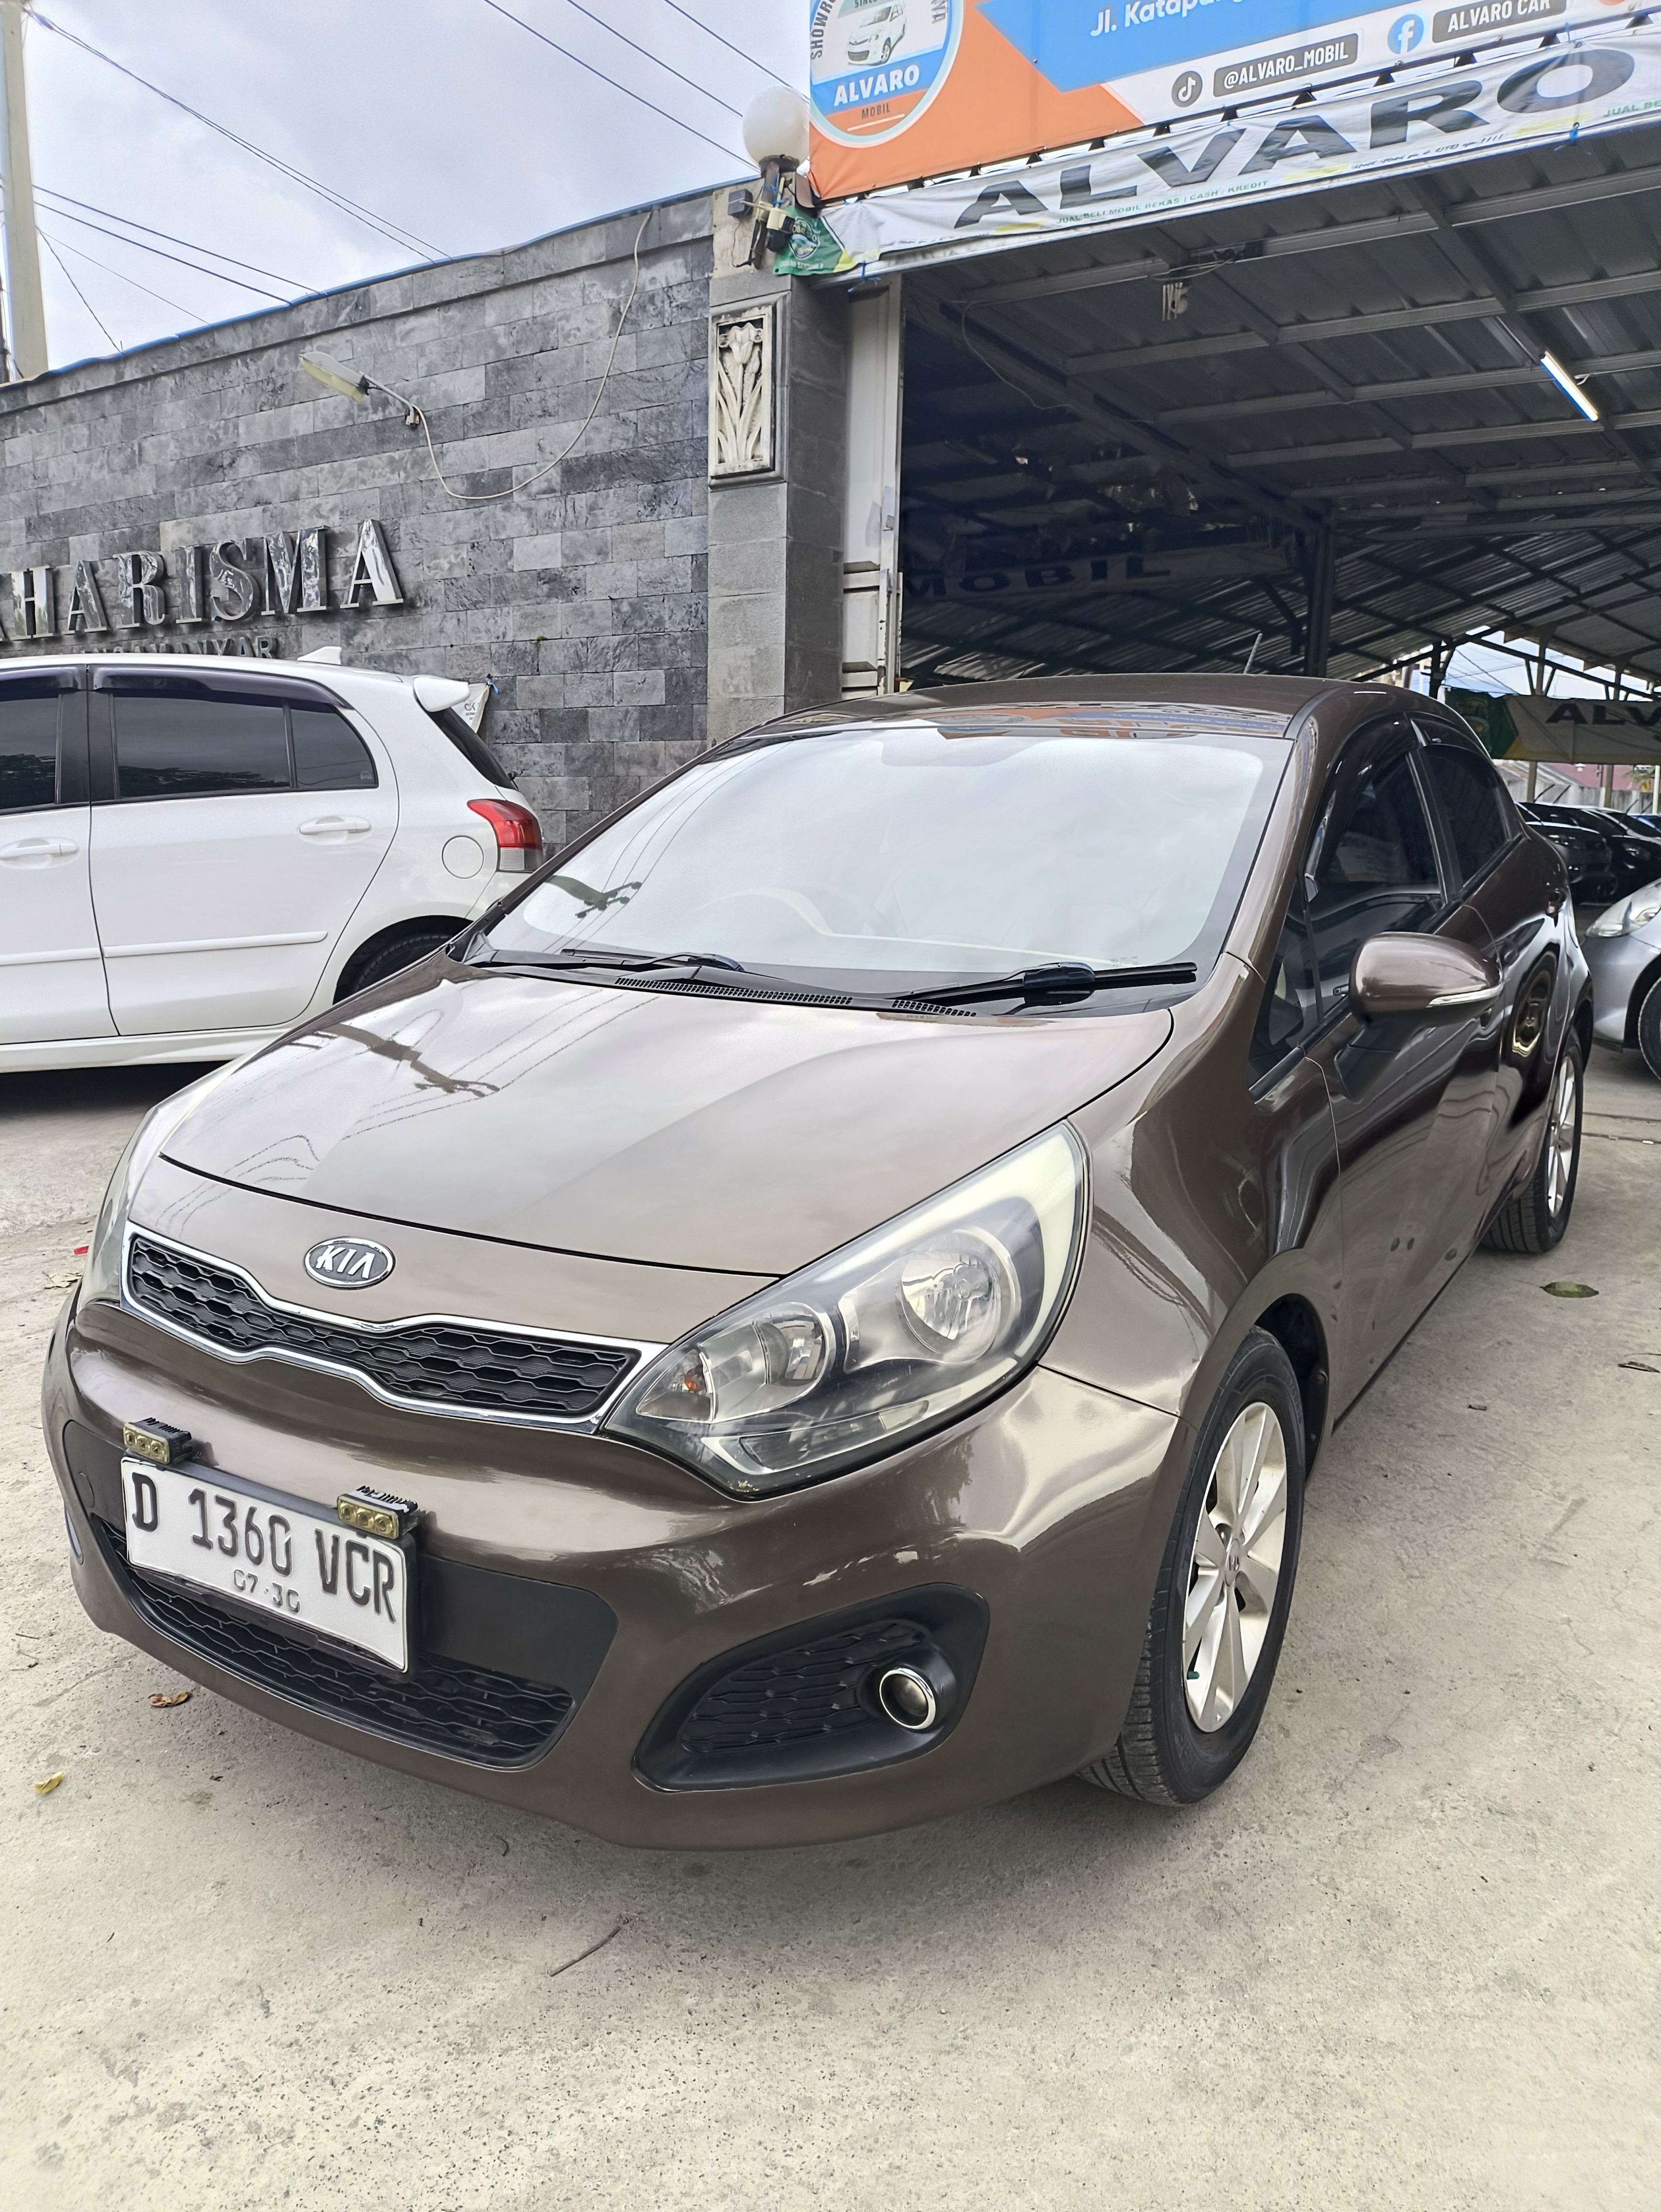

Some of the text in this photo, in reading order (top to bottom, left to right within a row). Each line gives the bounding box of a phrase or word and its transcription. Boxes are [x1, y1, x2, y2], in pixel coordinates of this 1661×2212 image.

[1090, 9, 1117, 36] Jl.
[1448, 1, 1512, 32] ALVARO
[834, 65, 919, 107] ALVARO
[1224, 42, 1348, 89] @ALVARO_MOBIL
[862, 103, 890, 119] MOBIL
[1604, 105, 1639, 117] JUAL
[954, 49, 1635, 229] ALVARO
[1056, 215, 1081, 224] JUAL
[1083, 210, 1106, 219] BELI
[1109, 206, 1141, 215] MOBIL
[1145, 198, 1180, 209] BEKAS
[1189, 190, 1218, 200] CASH
[1228, 180, 1269, 193] KREDIT
[0, 519, 403, 641] HARISMA
[316, 1245, 375, 1279] KIA
[132, 1471, 395, 1625] D 1360 VCR
